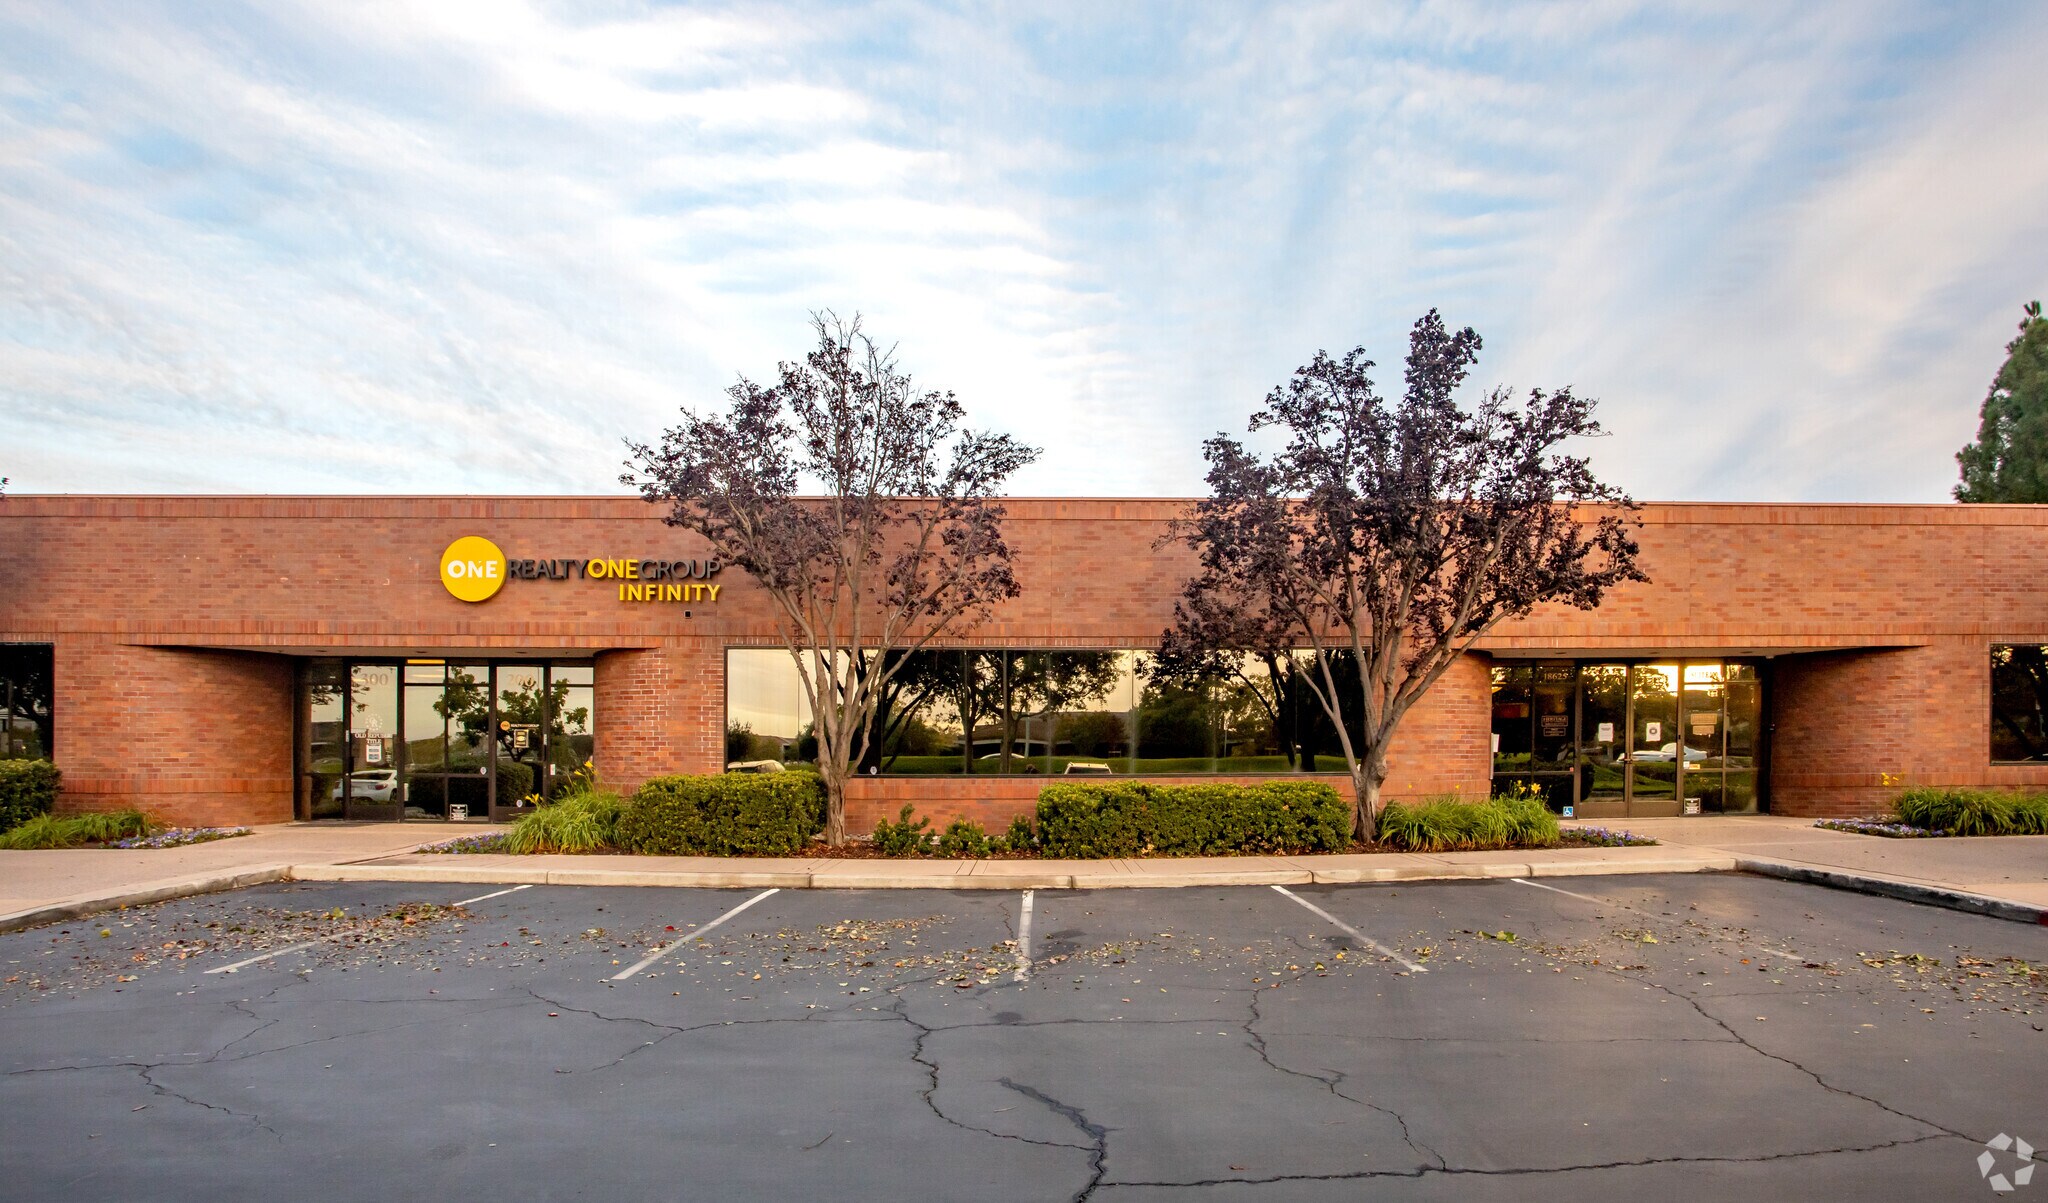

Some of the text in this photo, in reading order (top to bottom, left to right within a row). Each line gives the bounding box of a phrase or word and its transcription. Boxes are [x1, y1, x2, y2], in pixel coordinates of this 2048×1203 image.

[447, 560, 498, 578] ONE
[619, 583, 721, 602] INFINITY
[1543, 672, 1569, 680] 18625
